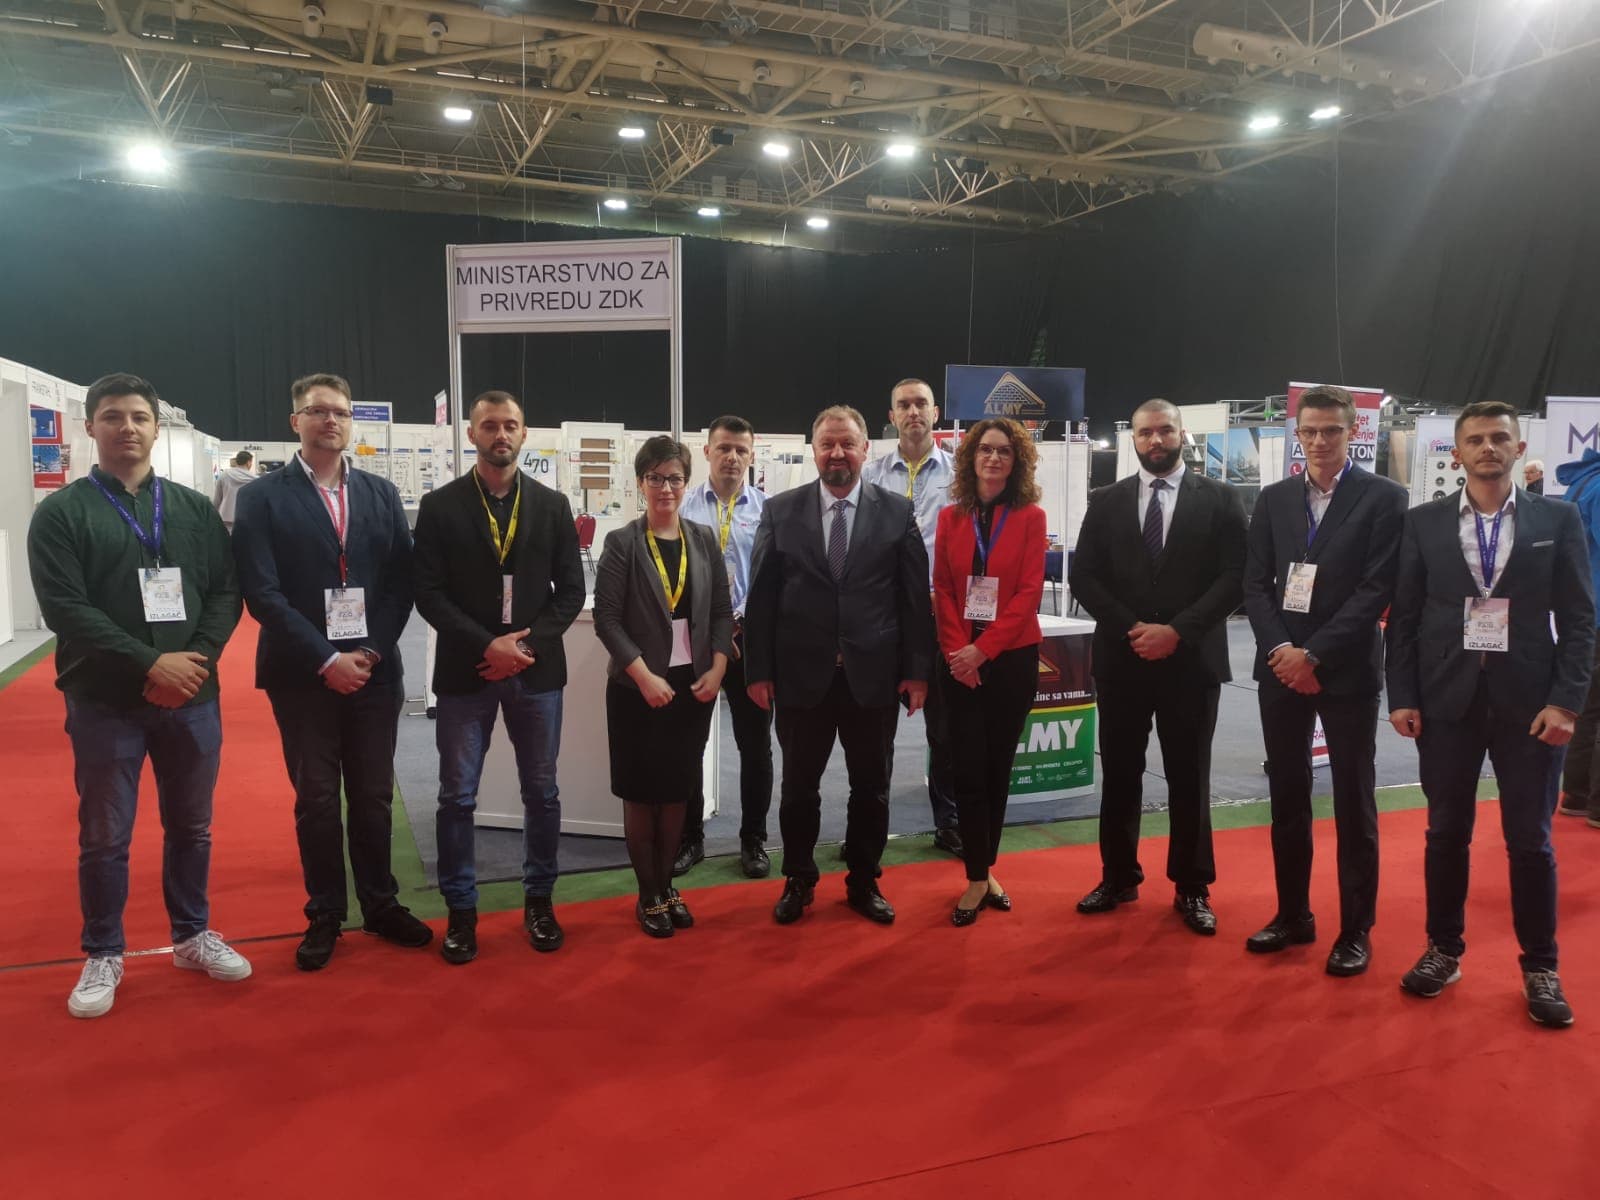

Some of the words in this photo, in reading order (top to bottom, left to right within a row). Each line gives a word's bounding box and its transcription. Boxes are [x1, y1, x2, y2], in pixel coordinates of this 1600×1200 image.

[456, 261, 633, 285] MINISTARSTVNO
[641, 260, 670, 280] ZA
[480, 290, 591, 311] PRIVREDU
[598, 289, 643, 309] ZDK
[984, 402, 1022, 415] ALMY
[1355, 413, 1369, 426] tet
[1356, 428, 1376, 442] enja!
[1568, 422, 1600, 454] M
[1349, 445, 1376, 459] TON
[523, 452, 549, 474] 470
[1468, 640, 1505, 650] IZLAGAČ
[1052, 692, 1062, 700] sa
